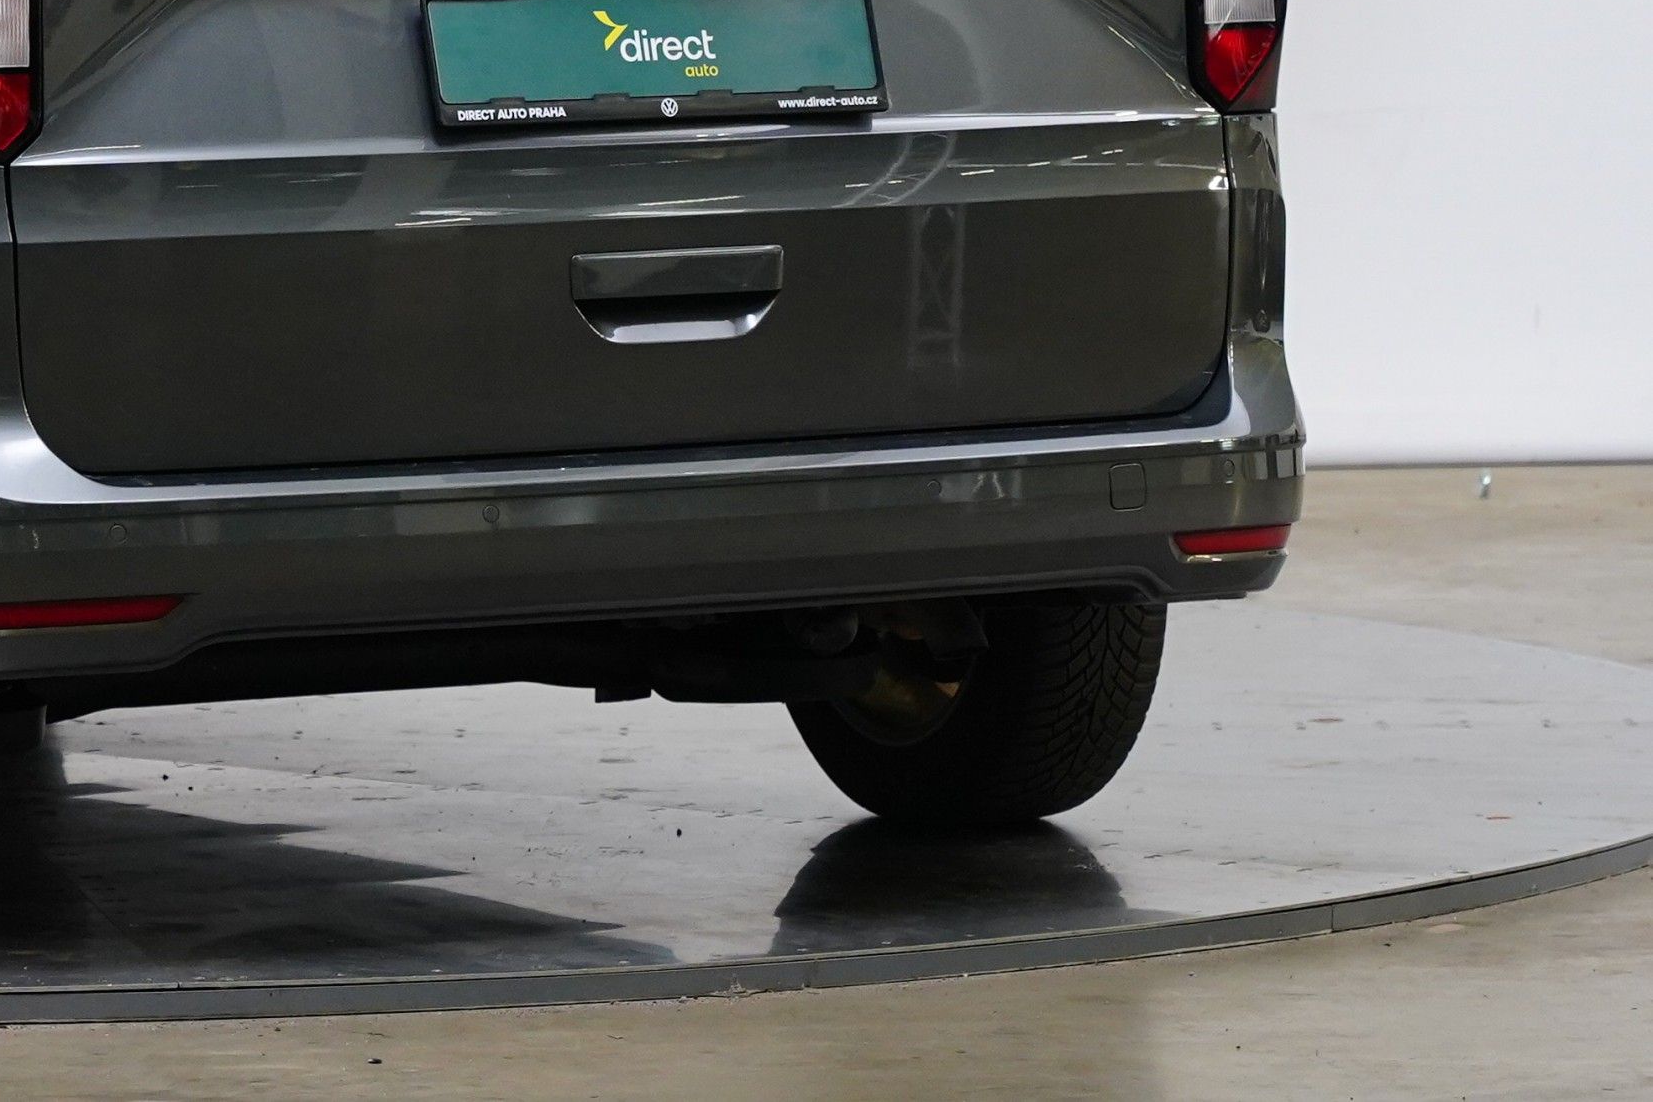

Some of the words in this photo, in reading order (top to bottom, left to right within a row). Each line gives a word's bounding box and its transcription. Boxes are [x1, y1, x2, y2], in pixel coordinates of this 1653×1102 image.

[619, 28, 717, 63] direct
[684, 63, 719, 78] auto
[777, 95, 878, 109] www.direct-auto.cz
[457, 108, 496, 122] DIRECT
[497, 107, 528, 120] AUTO
[528, 105, 567, 119] PRAHA
